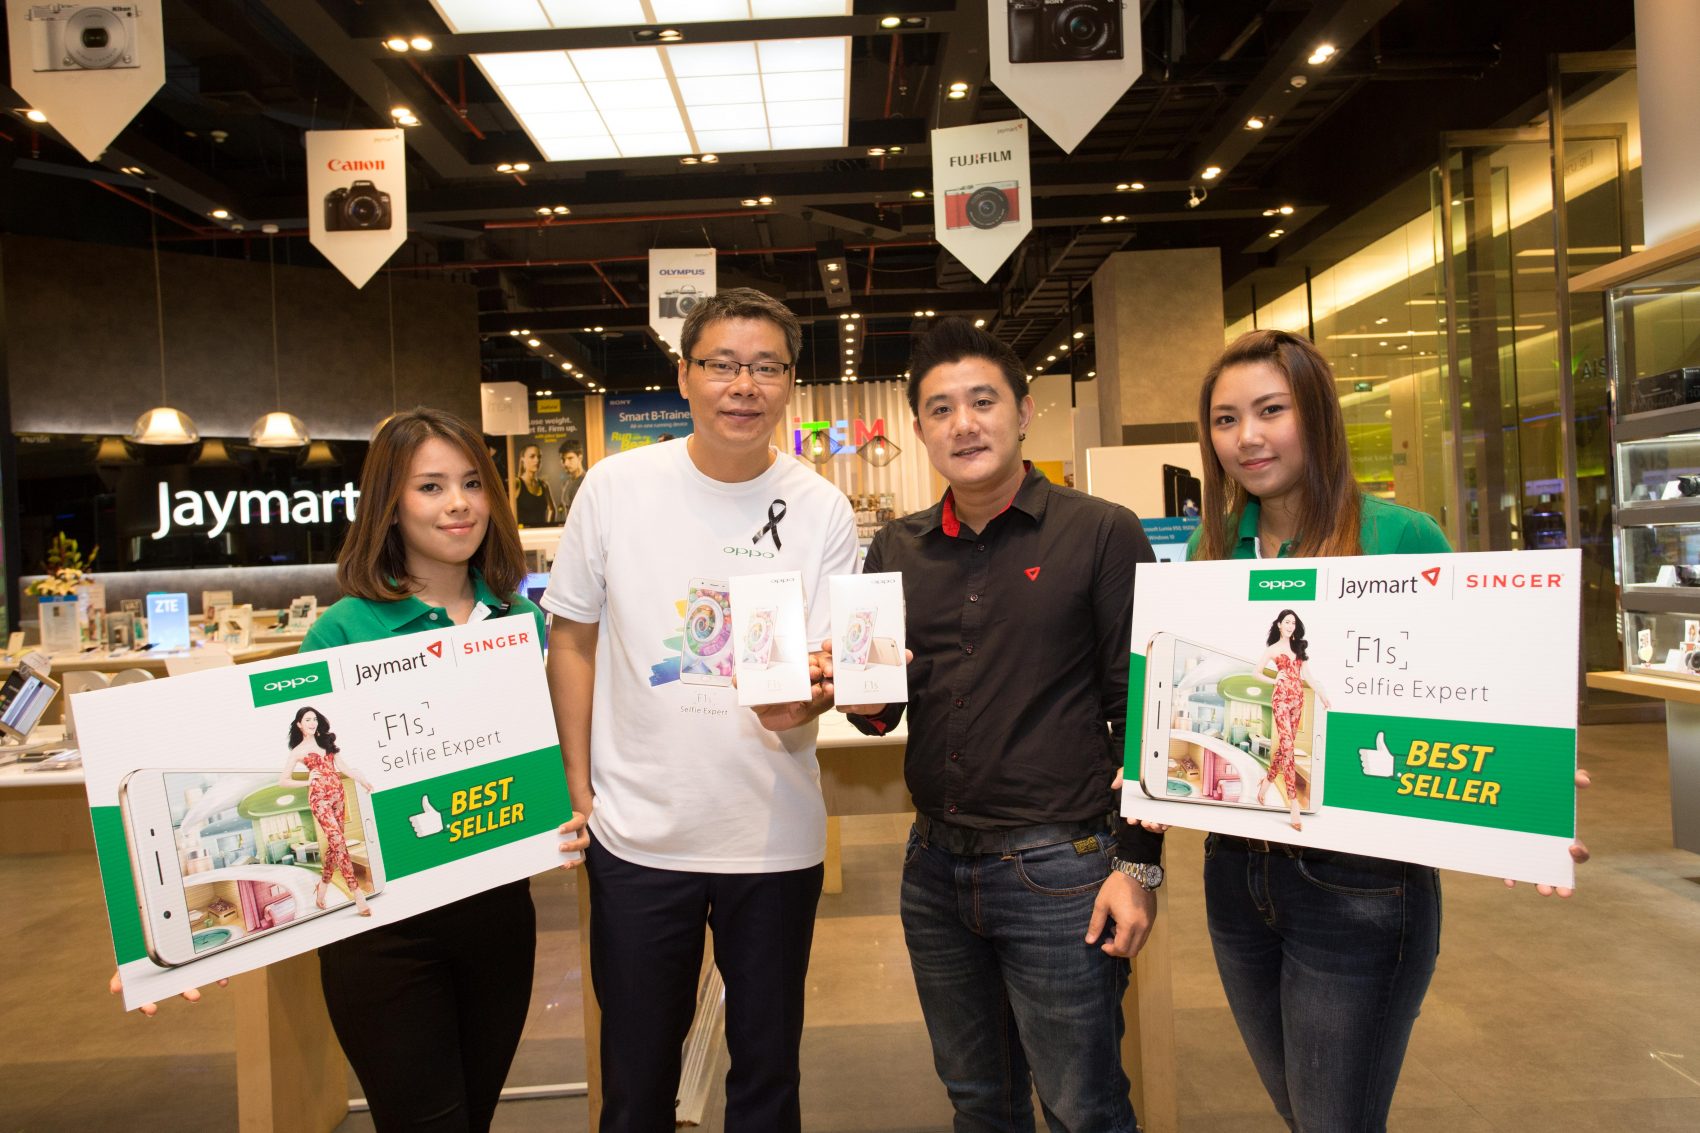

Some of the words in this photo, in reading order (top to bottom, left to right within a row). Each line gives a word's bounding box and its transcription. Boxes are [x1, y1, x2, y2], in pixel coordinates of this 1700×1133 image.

[327, 159, 385, 172] Canon
[949, 150, 1012, 167] FUJIFILM
[619, 411, 649, 422] Smart
[151, 481, 361, 540] Jaymart
[723, 546, 775, 558] oppo
[1258, 579, 1306, 589] oppo
[1338, 576, 1418, 599] Jaymart
[1466, 573, 1562, 588] SINGER
[155, 599, 179, 613] ZTE
[263, 674, 319, 692] oppo
[355, 651, 428, 686] Jaymart
[463, 632, 530, 655] SINGER
[1356, 636, 1397, 665] F1s
[1344, 676, 1404, 697] Selfie
[1413, 680, 1489, 704] Expert
[680, 705, 702, 713] Selfie
[703, 707, 728, 716] Expert
[384, 712, 424, 741] F1s
[381, 747, 436, 772] Selfie
[442, 730, 502, 757] Expert
[1405, 740, 1495, 773] BEST
[451, 776, 514, 816] BEST
[1396, 772, 1502, 806] SELLER
[449, 803, 525, 842] SELLER
